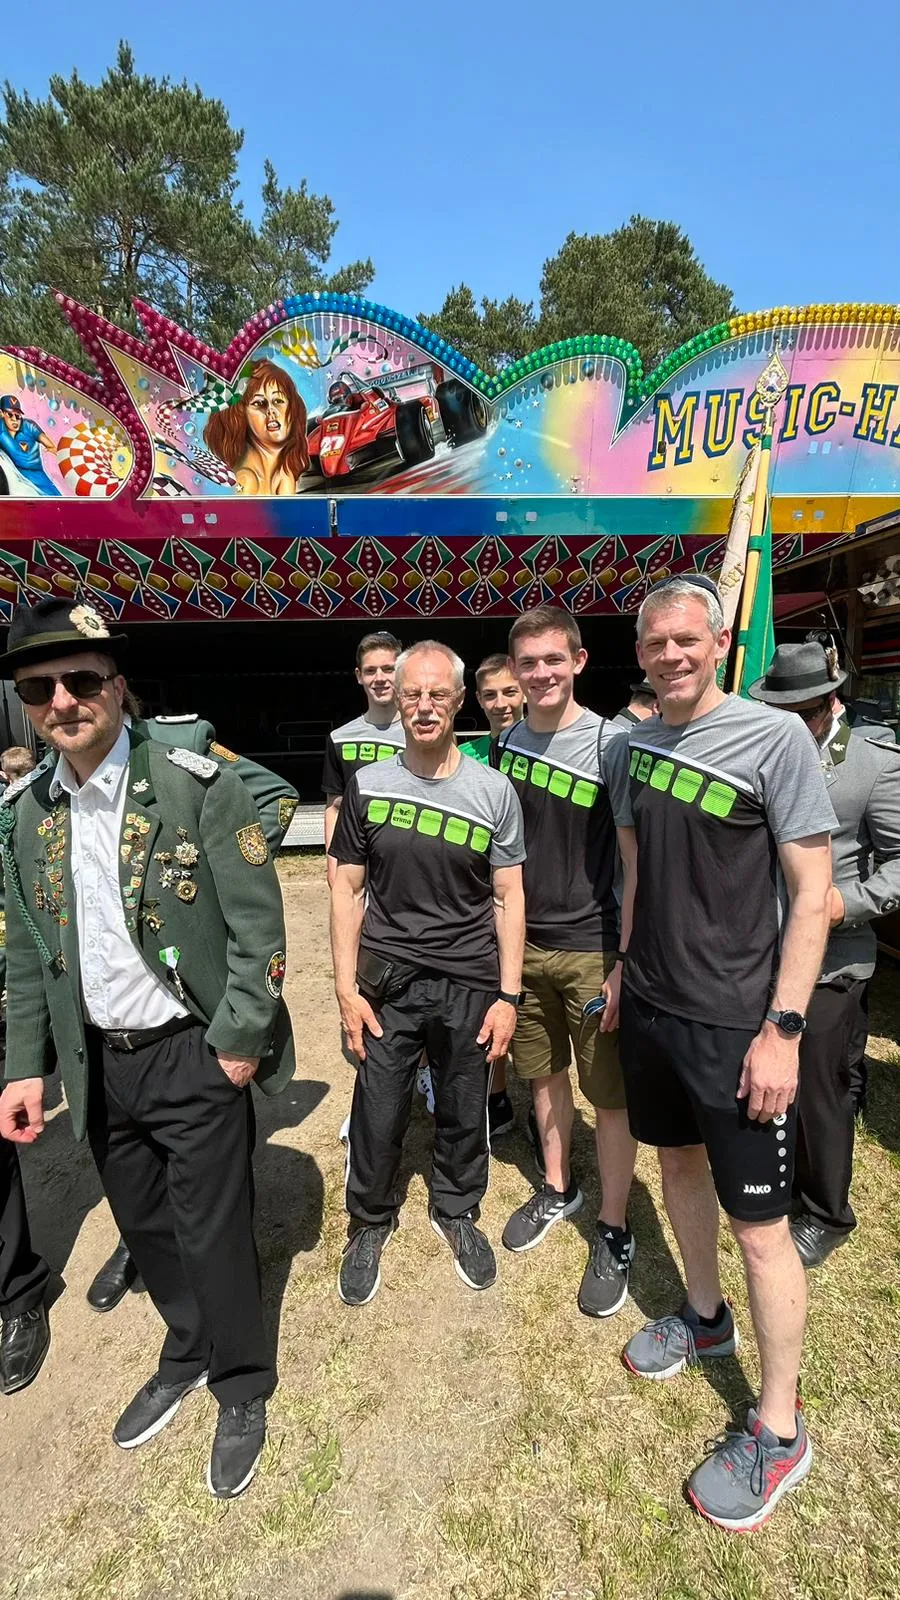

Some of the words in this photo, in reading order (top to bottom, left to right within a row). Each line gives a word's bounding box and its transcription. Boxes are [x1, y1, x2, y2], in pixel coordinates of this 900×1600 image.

[647, 381, 900, 472] MUSIC-H
[320, 434, 345, 455] 27
[743, 1184, 772, 1194] JAKO
